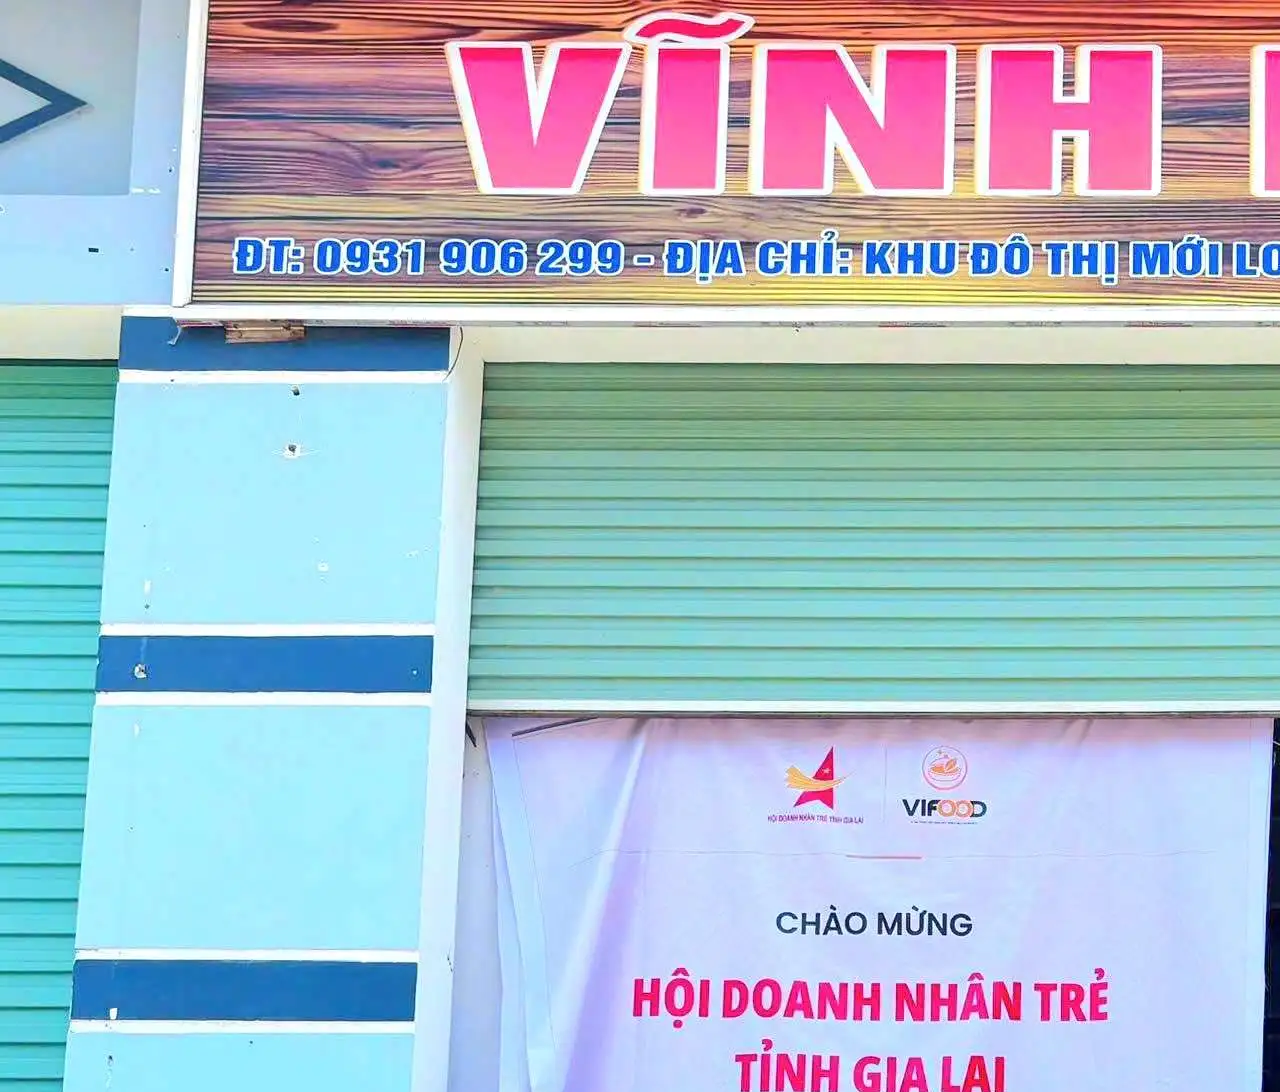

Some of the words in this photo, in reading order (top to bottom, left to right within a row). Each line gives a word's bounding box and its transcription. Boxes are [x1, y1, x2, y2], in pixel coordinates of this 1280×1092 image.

[445, 12, 1162, 196] VĨNH
[236, 239, 302, 274] ĐT:
[315, 239, 423, 275] 0931
[440, 239, 527, 275] 906
[536, 240, 623, 275] 299
[665, 240, 745, 283] ĐỊA
[757, 231, 851, 275] CHỈ:
[864, 240, 959, 276] KHU
[969, 234, 1032, 276] ĐÔ
[1045, 240, 1118, 284] THỊ
[1130, 234, 1222, 277] MỚI
[902, 799, 988, 818] VIFOOD
[775, 905, 867, 936] CHÀO
[877, 905, 973, 937] MỪNG
[633, 967, 710, 1029] HỘI
[721, 979, 881, 1021] DOANH
[894, 972, 1022, 1022] NHÂN
[1034, 968, 1109, 1022] TRẺ
[735, 1038, 840, 1092] TỈNH
